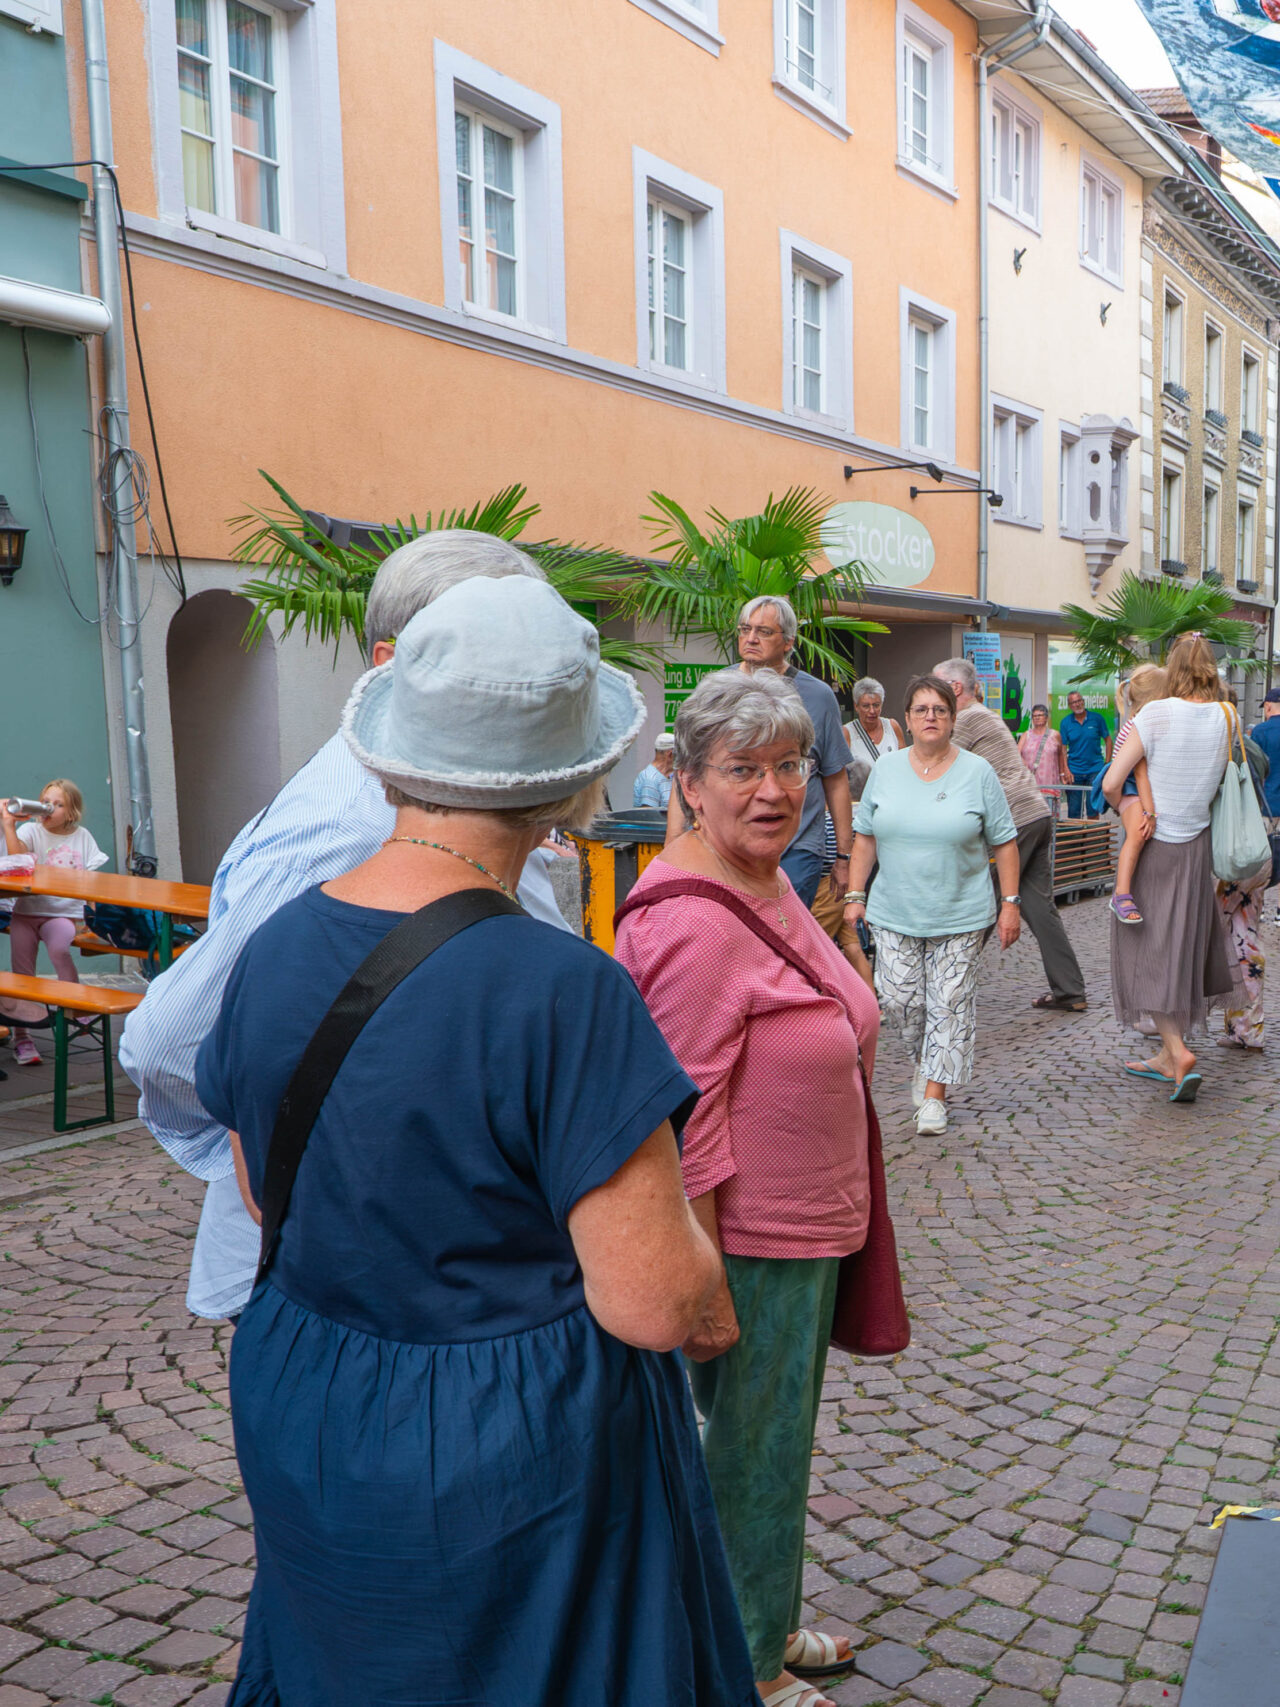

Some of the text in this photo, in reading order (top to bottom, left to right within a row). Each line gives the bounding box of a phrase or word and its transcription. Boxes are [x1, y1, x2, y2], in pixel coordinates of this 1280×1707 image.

[846, 517, 933, 569] stocker
[685, 667, 694, 681] &
[1058, 695, 1068, 710] zu
